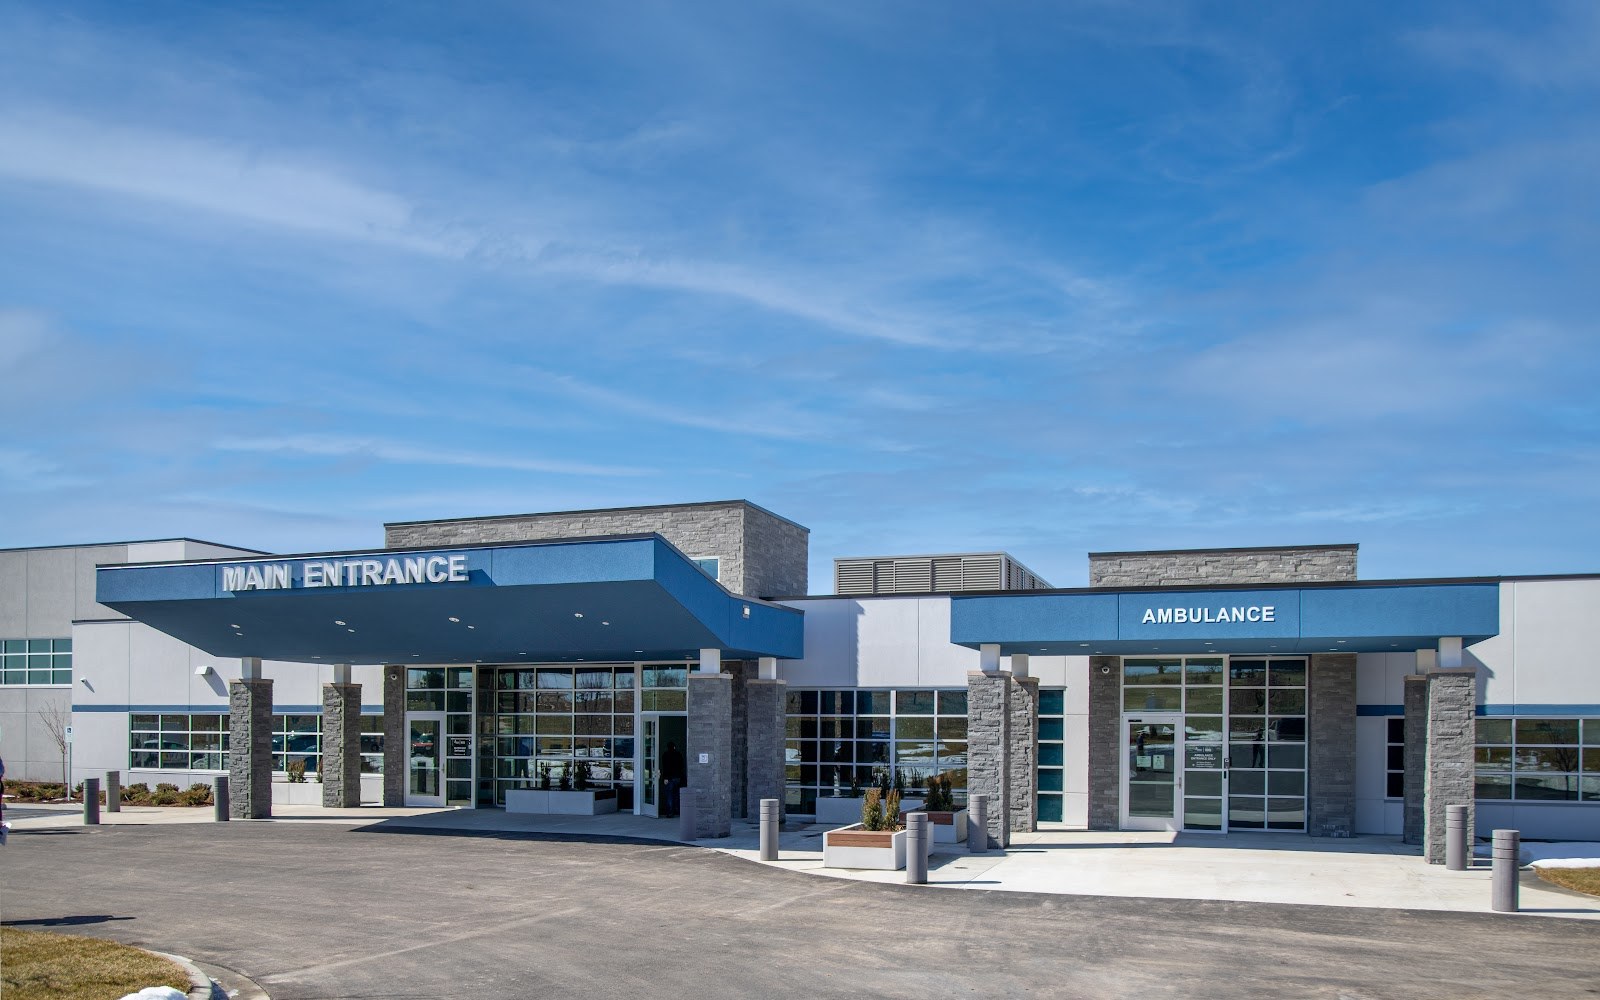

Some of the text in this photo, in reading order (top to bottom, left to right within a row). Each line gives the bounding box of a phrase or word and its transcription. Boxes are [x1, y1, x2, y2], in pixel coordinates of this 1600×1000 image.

[222, 555, 469, 592] MAIN ENTRANCE
[1142, 606, 1276, 624] AMBULANCE
